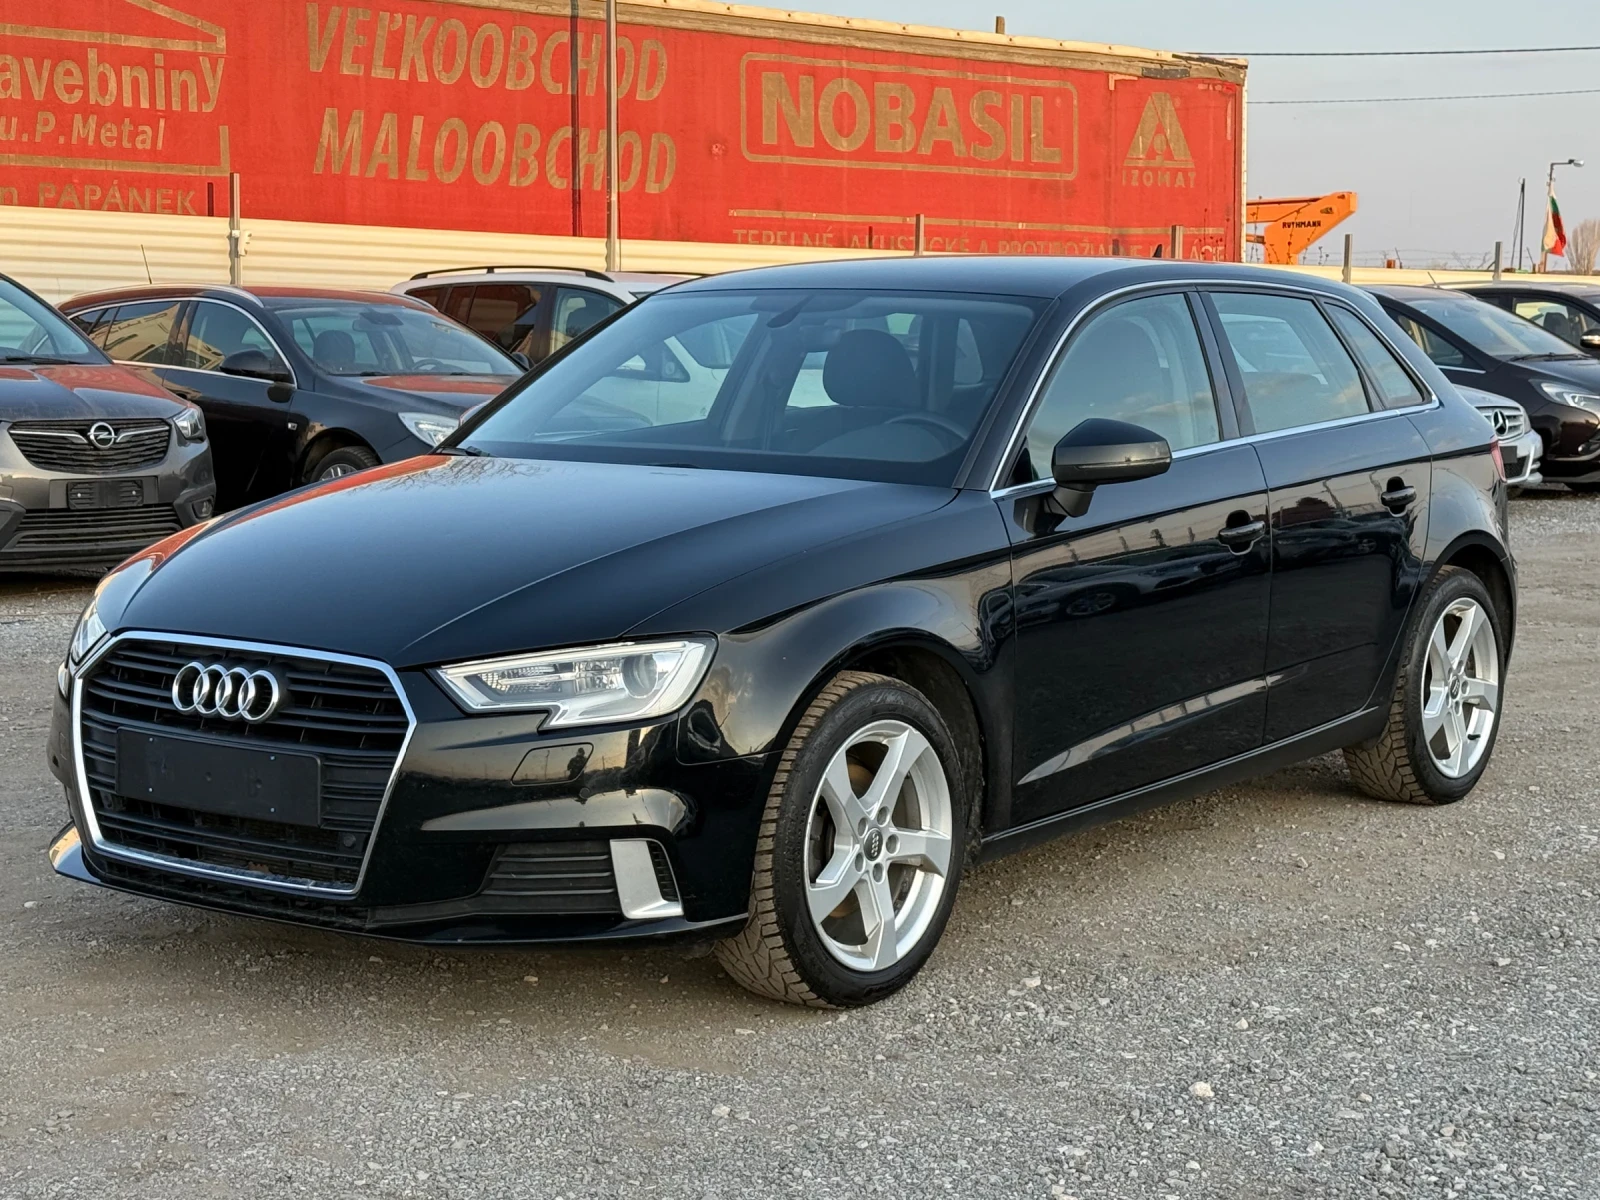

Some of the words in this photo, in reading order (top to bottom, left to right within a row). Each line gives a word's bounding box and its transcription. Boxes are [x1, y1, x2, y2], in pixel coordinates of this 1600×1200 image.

[306, 3, 668, 101] VEĽKOOBCHOD
[313, 107, 677, 194] MALOOBCHOD
[761, 71, 1062, 164] NOBASIL
[38, 180, 198, 215] PAPÁNEK
[1122, 169, 1196, 188] IZOMAT
